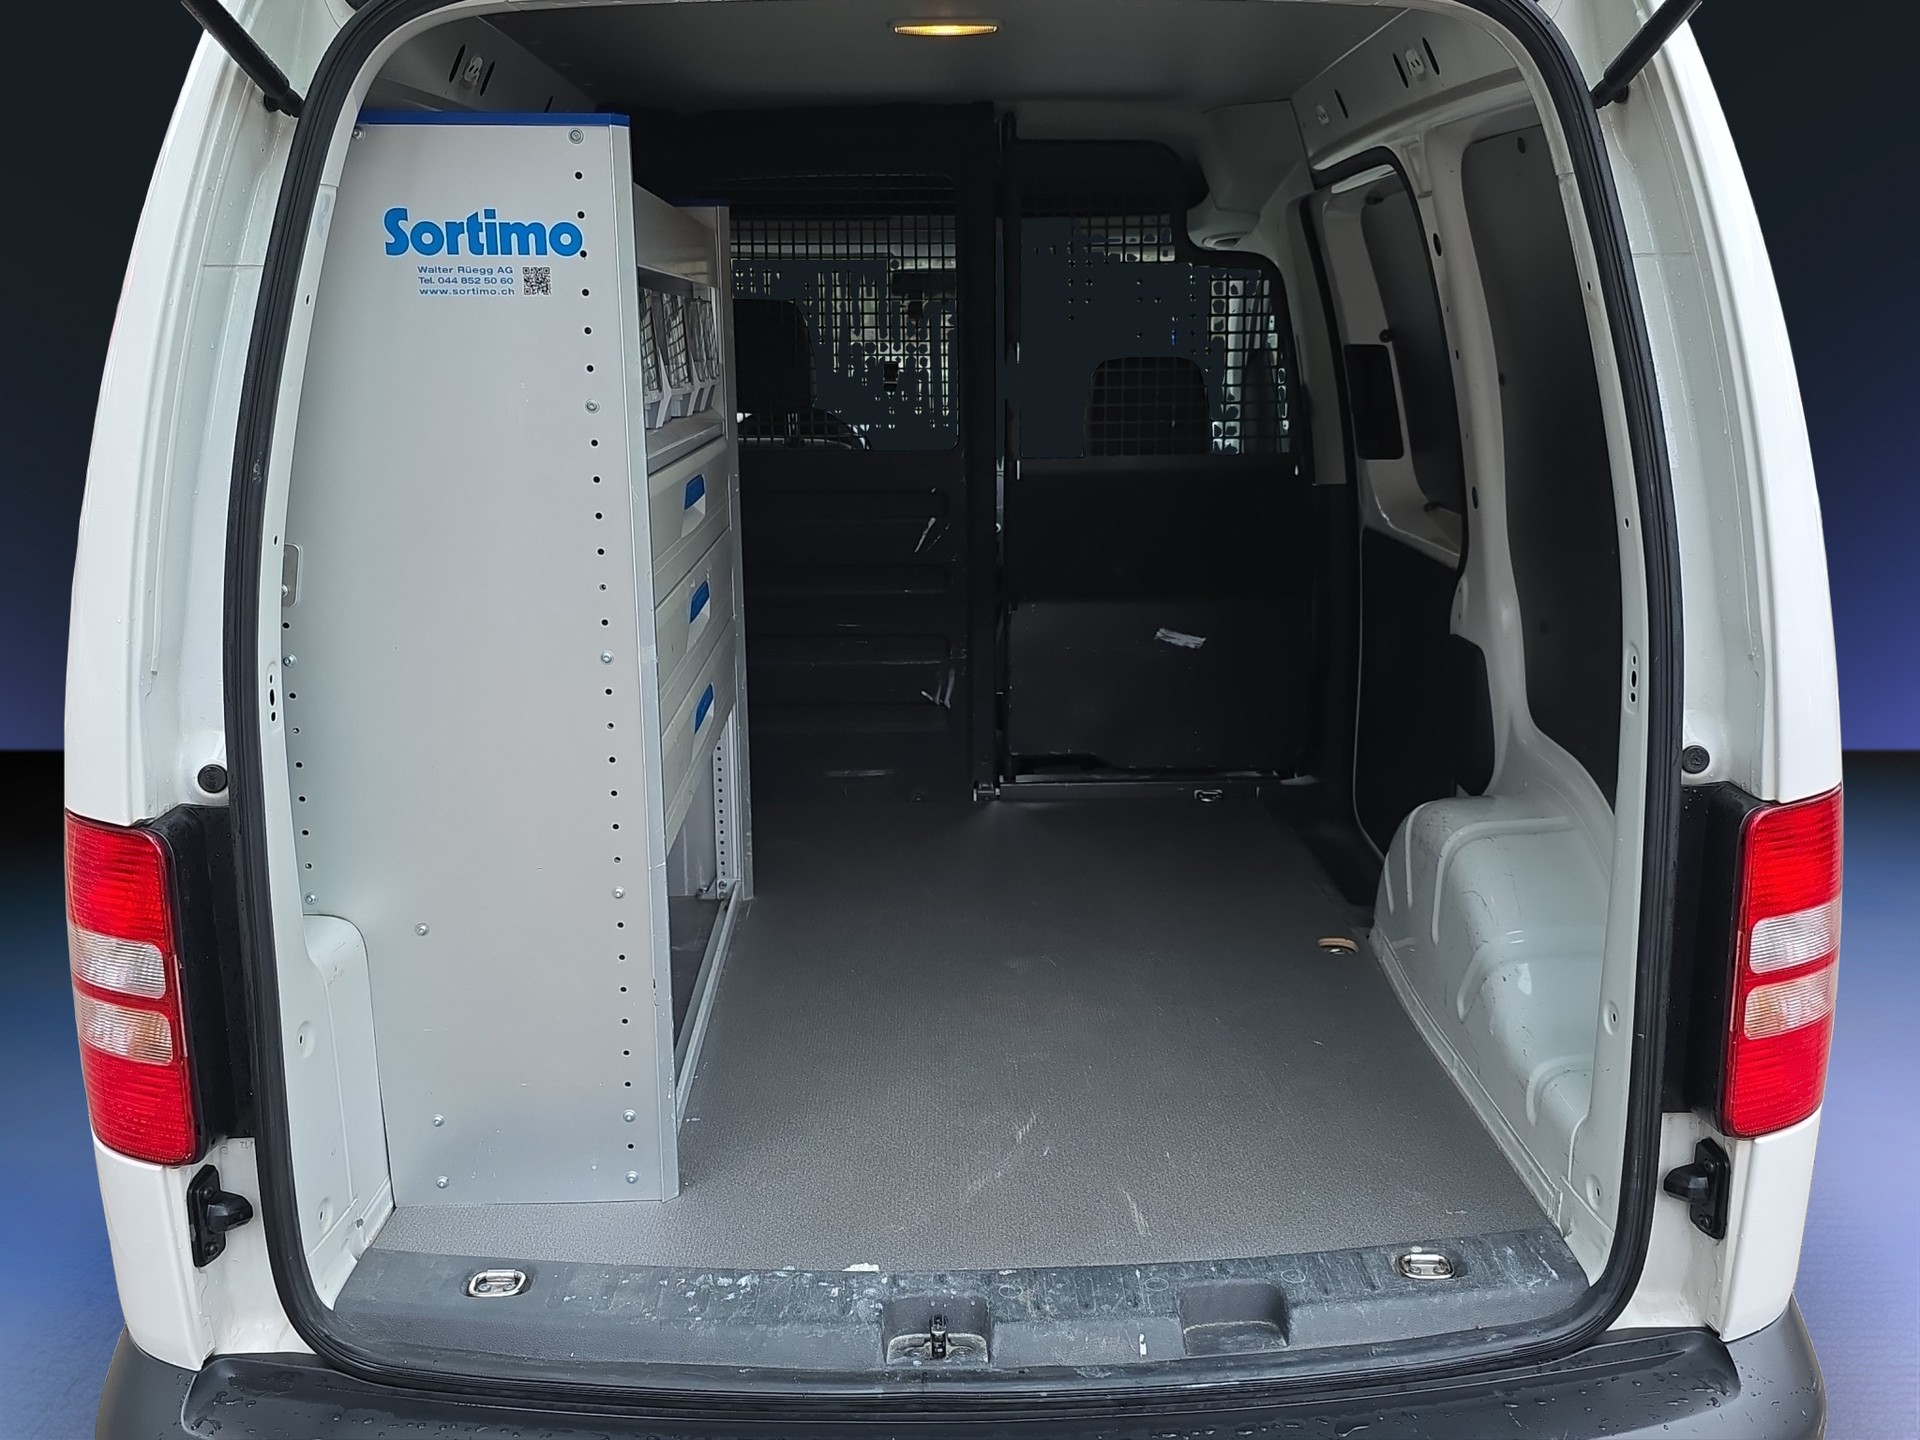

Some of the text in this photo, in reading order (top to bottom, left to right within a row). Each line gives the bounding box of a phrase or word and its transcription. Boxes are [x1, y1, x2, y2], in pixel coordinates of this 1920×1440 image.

[384, 207, 583, 257] Sortimo
[417, 265, 513, 275] Walter Rüegg AG
[418, 276, 514, 285] Tel. 044 852 50 60
[419, 287, 515, 296] www.sortimo.ch
